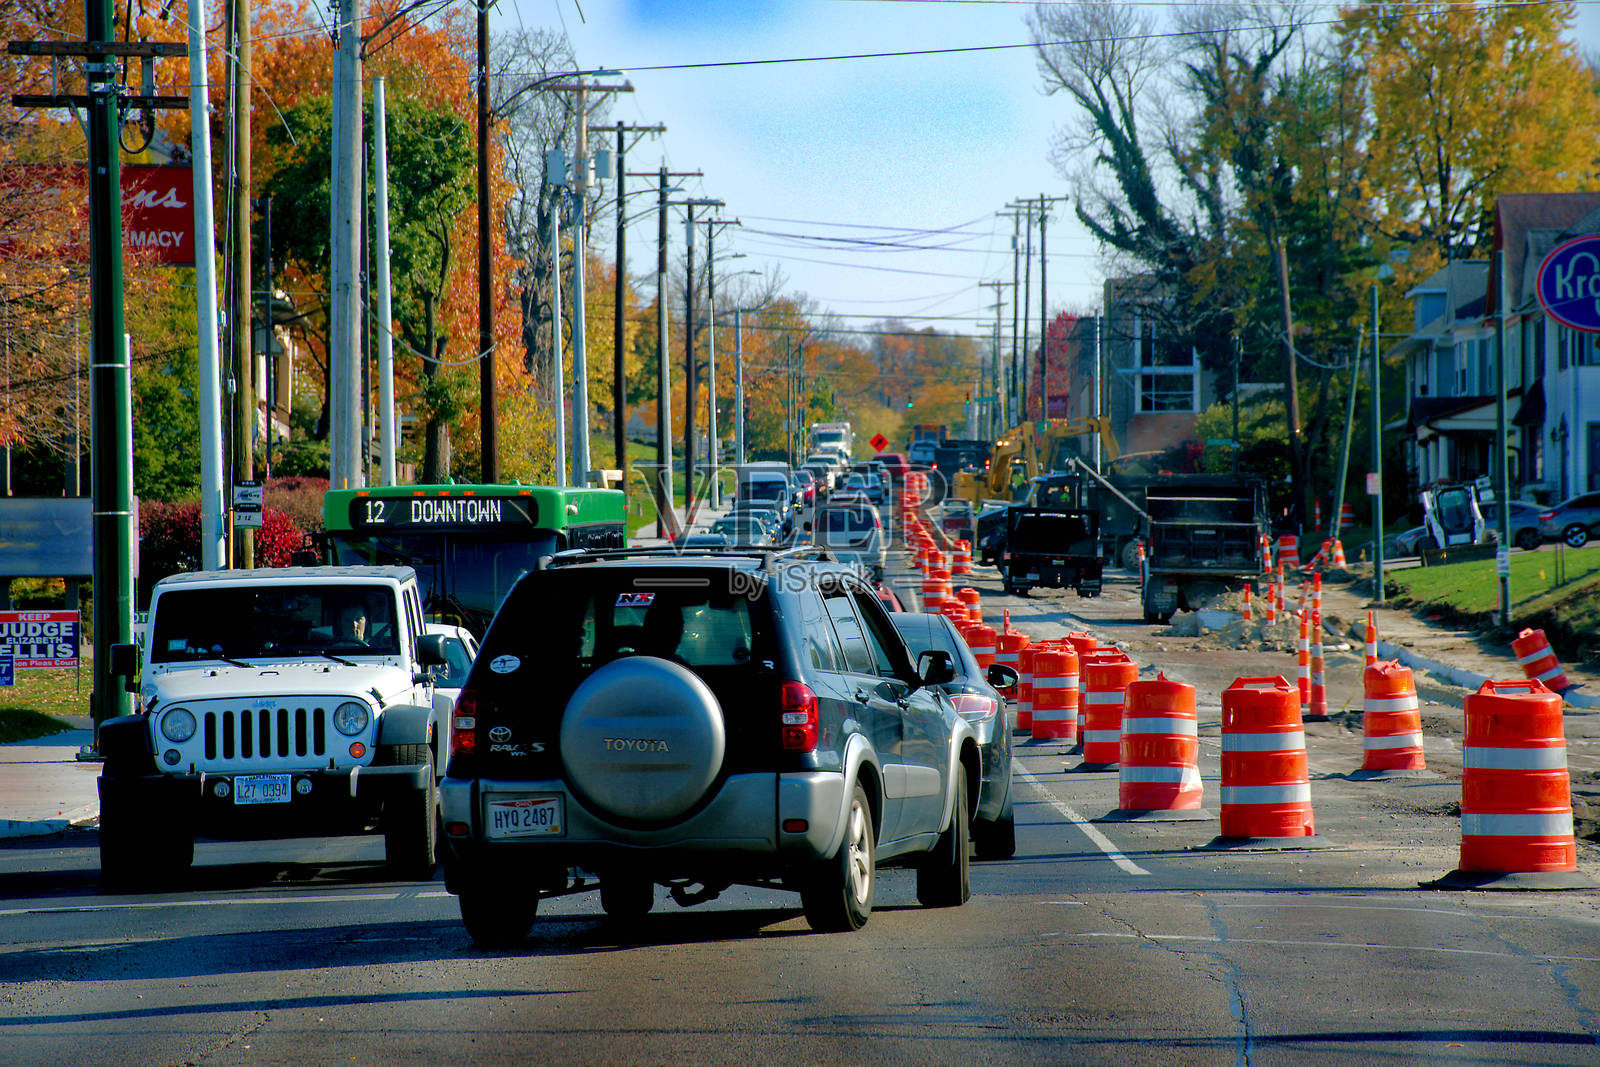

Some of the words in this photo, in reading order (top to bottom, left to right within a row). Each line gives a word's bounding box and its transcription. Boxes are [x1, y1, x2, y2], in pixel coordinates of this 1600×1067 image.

[365, 501, 385, 523] 12
[411, 500, 501, 523] DOWNTOWN
[18, 613, 51, 621] KEEP
[0, 622, 74, 637] JUDGE
[0, 643, 74, 658] ELLIS
[604, 738, 669, 752] TOYOTA
[237, 783, 256, 798] L27
[262, 783, 287, 798] 0394
[523, 807, 554, 827] 2487
